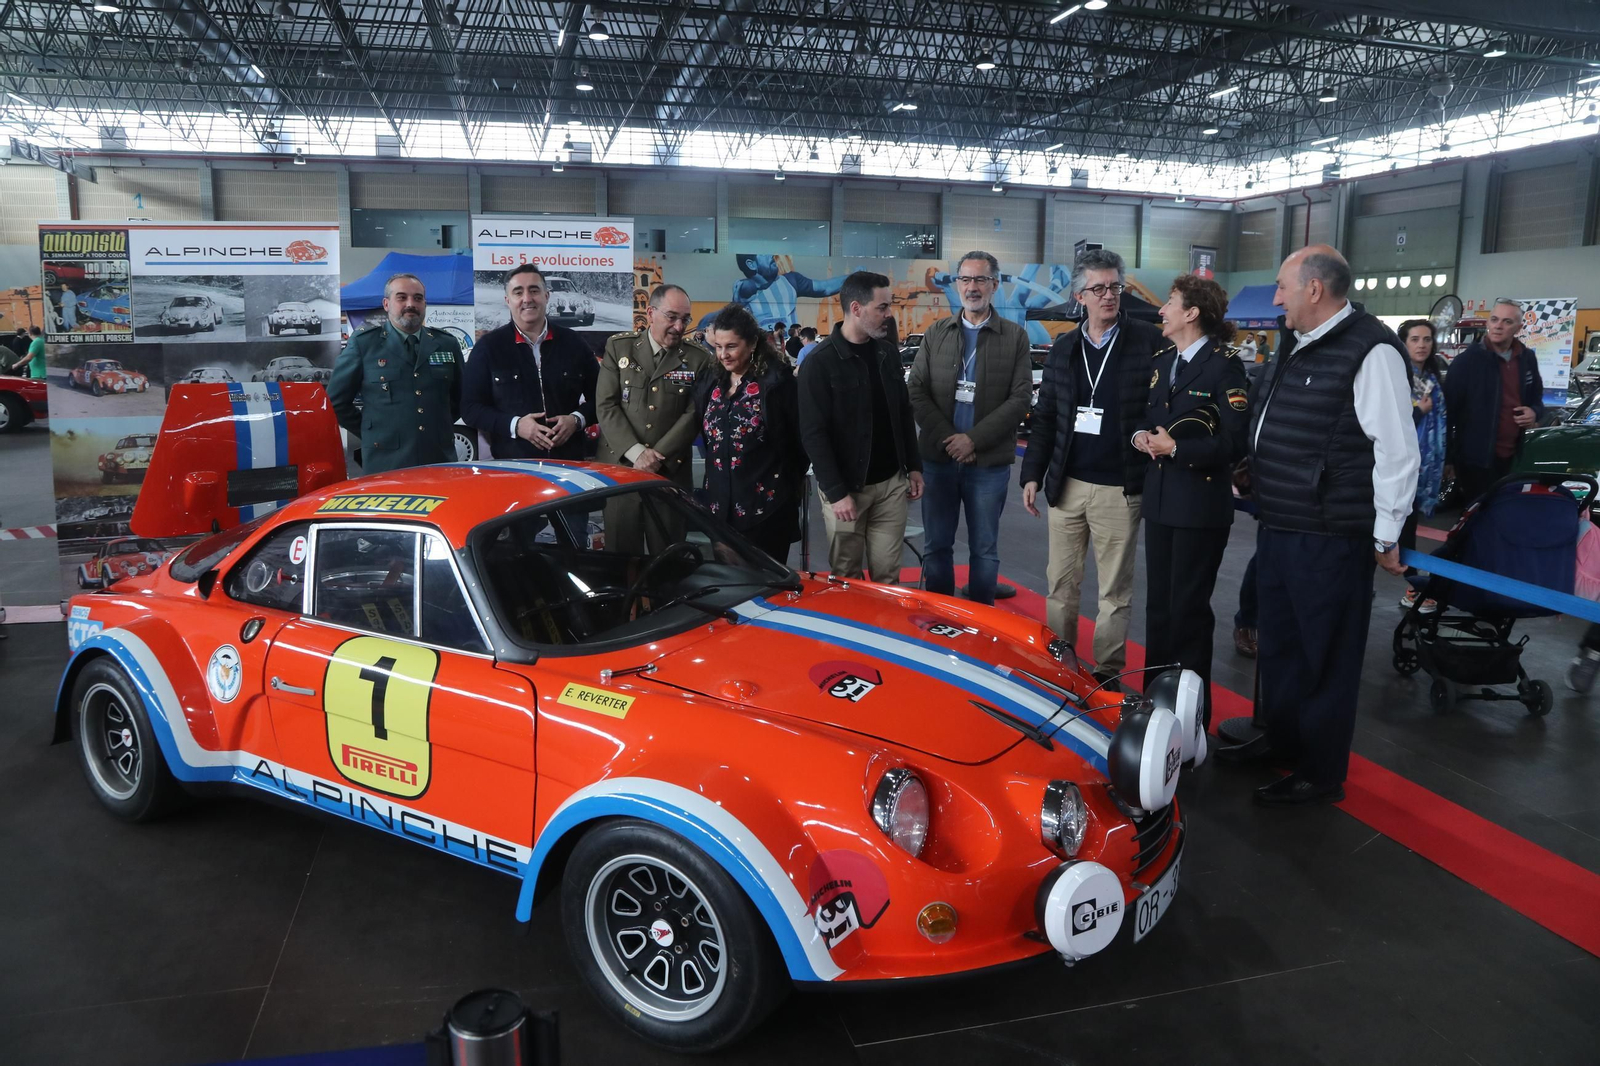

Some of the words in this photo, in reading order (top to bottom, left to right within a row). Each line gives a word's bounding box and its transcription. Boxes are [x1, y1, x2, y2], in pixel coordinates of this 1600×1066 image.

[43, 231, 126, 254] autopista
[478, 228, 592, 240] ALPINCHE
[145, 246, 283, 257] ALPINCHE
[491, 253, 514, 266] Las
[519, 253, 527, 265] 5
[532, 252, 615, 267] evoluciones
[84, 262, 100, 273] 100
[47, 334, 70, 343] ALPINE
[84, 334, 105, 342] MOTOR
[106, 334, 133, 342] PORSCHE
[318, 496, 445, 512] MICHELIN
[293, 539, 304, 560] E
[818, 670, 848, 690] MICHELIN
[359, 655, 398, 741] 1
[564, 687, 574, 699] E.
[577, 690, 629, 712] REVERTER
[341, 743, 419, 787] PIRELLI
[251, 758, 518, 874] ALPINCHE
[811, 879, 853, 906] MICHELIN
[1081, 901, 1119, 924] CIBIE
